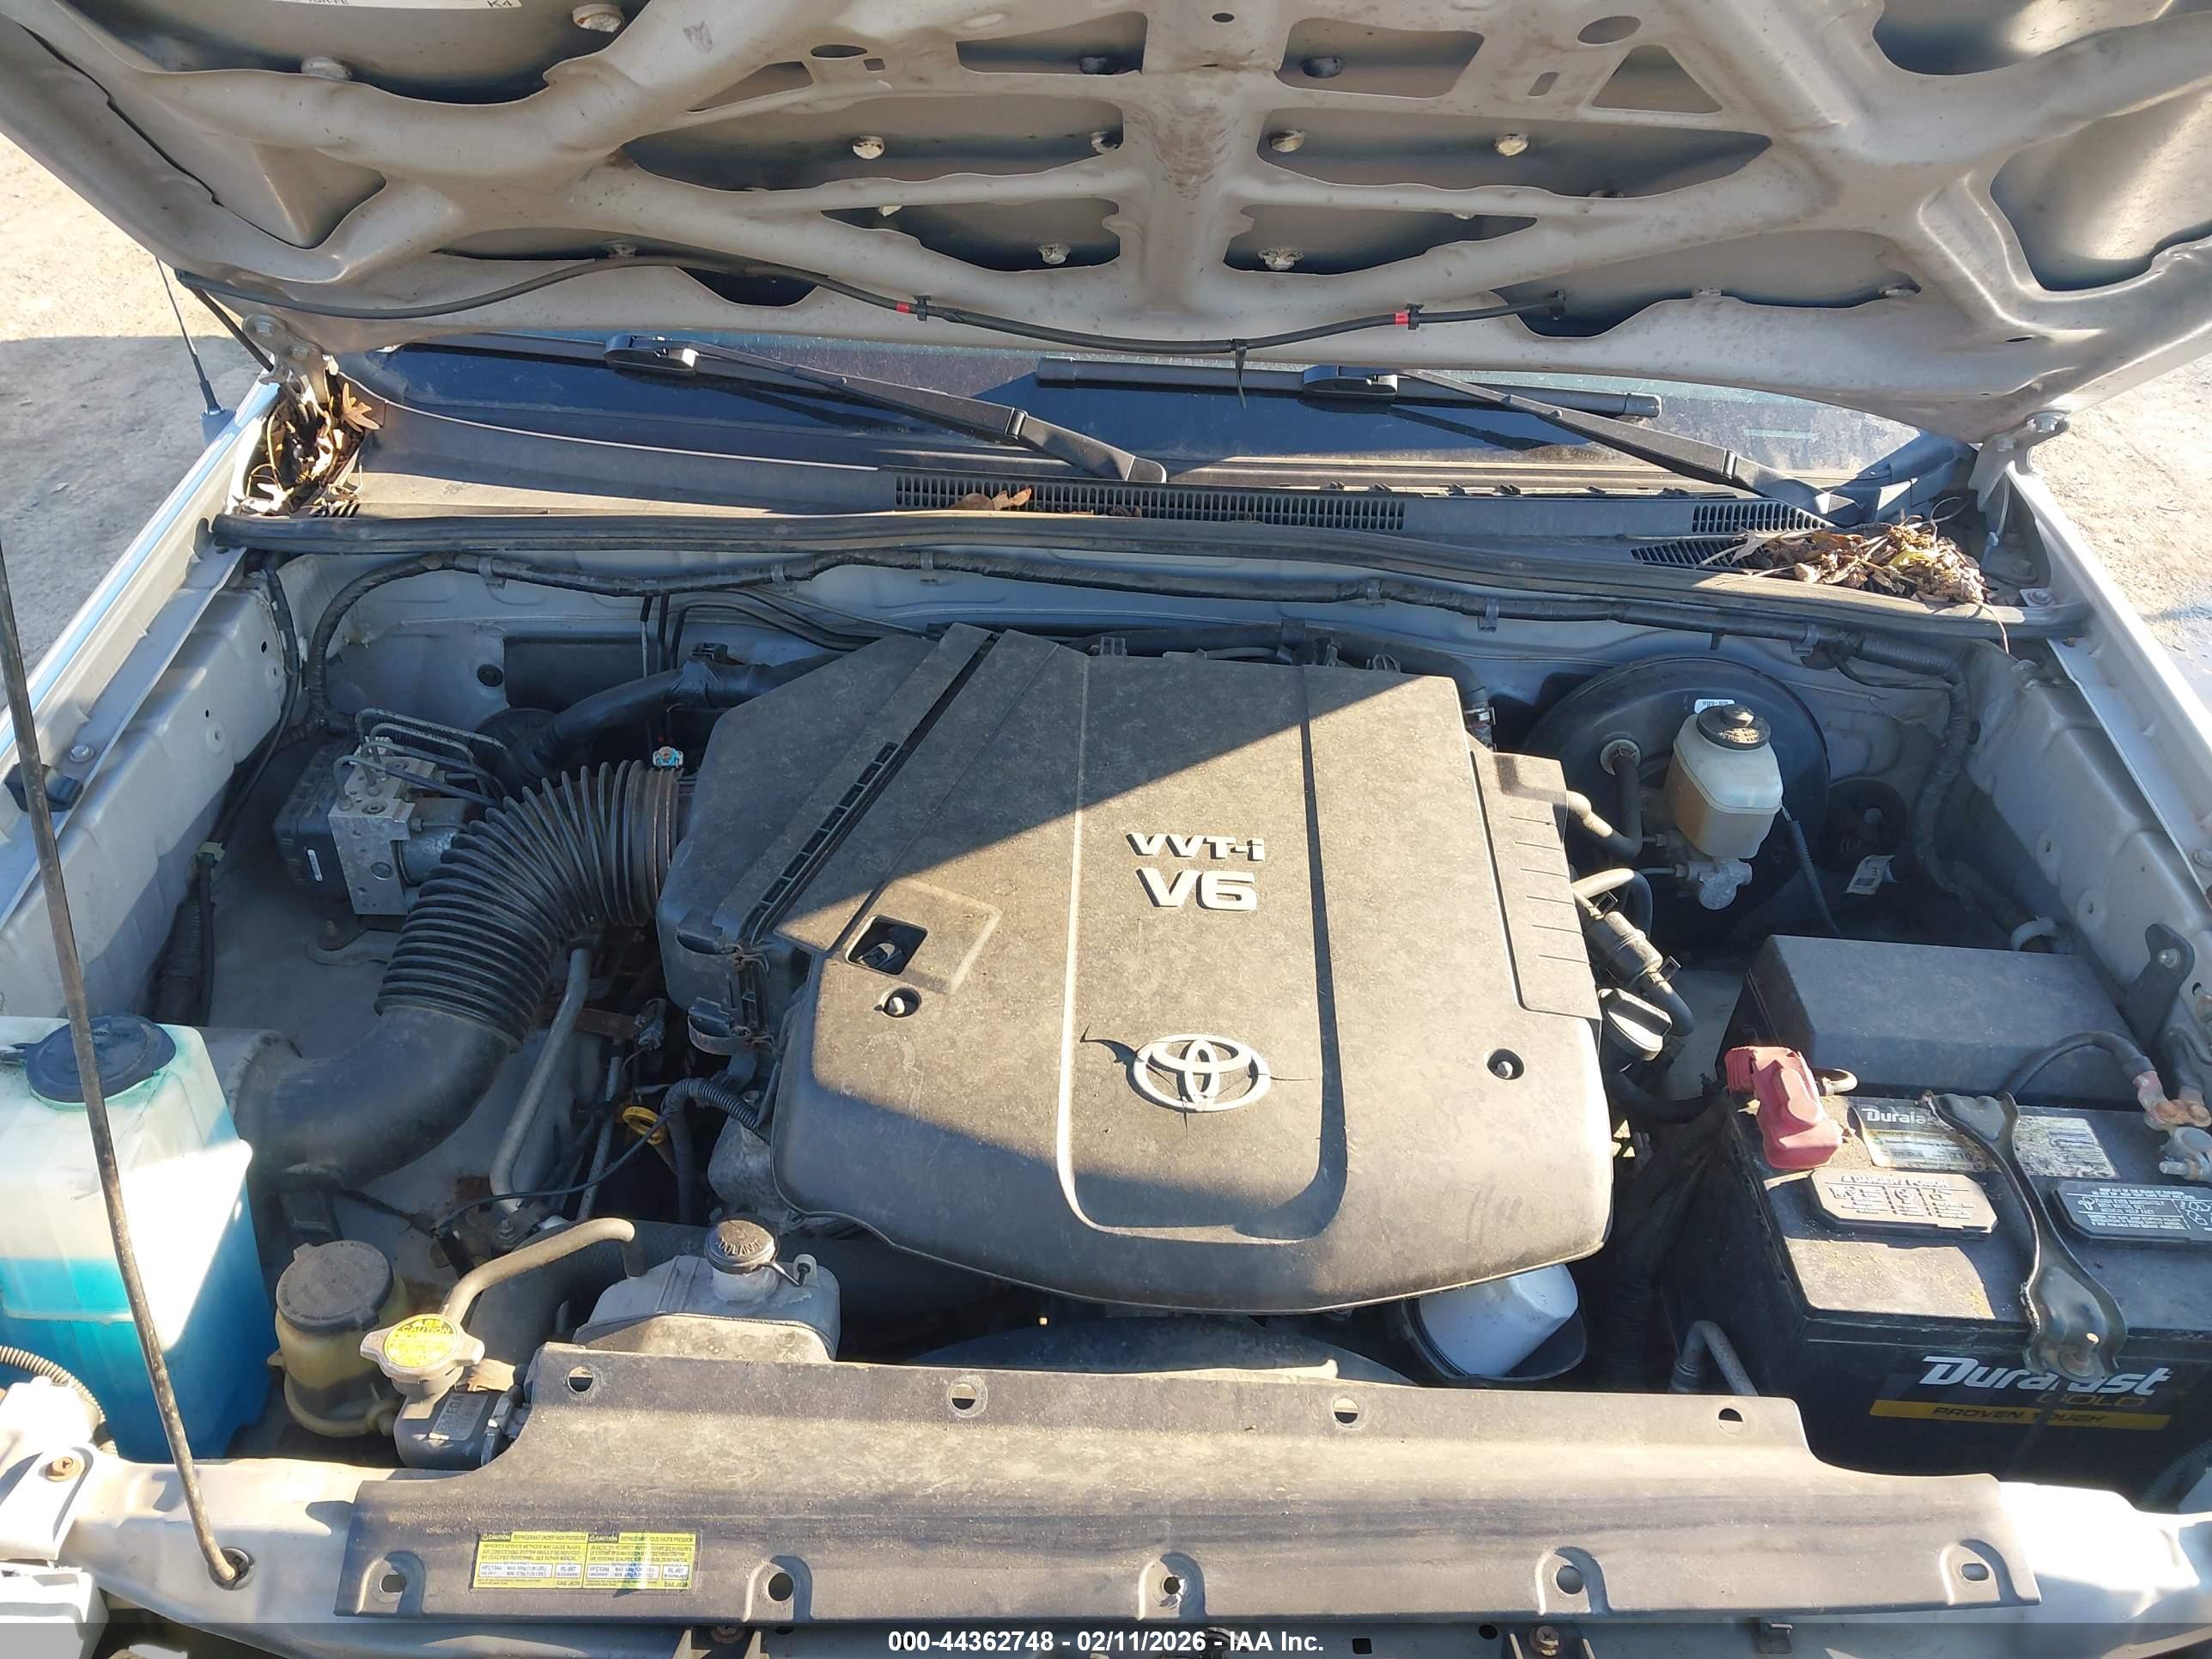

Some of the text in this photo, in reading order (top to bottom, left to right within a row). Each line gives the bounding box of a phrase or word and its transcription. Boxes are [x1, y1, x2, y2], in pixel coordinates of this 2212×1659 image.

[1126, 832, 1265, 862] VVT-i
[1135, 867, 1257, 912] V6
[1932, 1407, 2025, 1419] PROVEN
